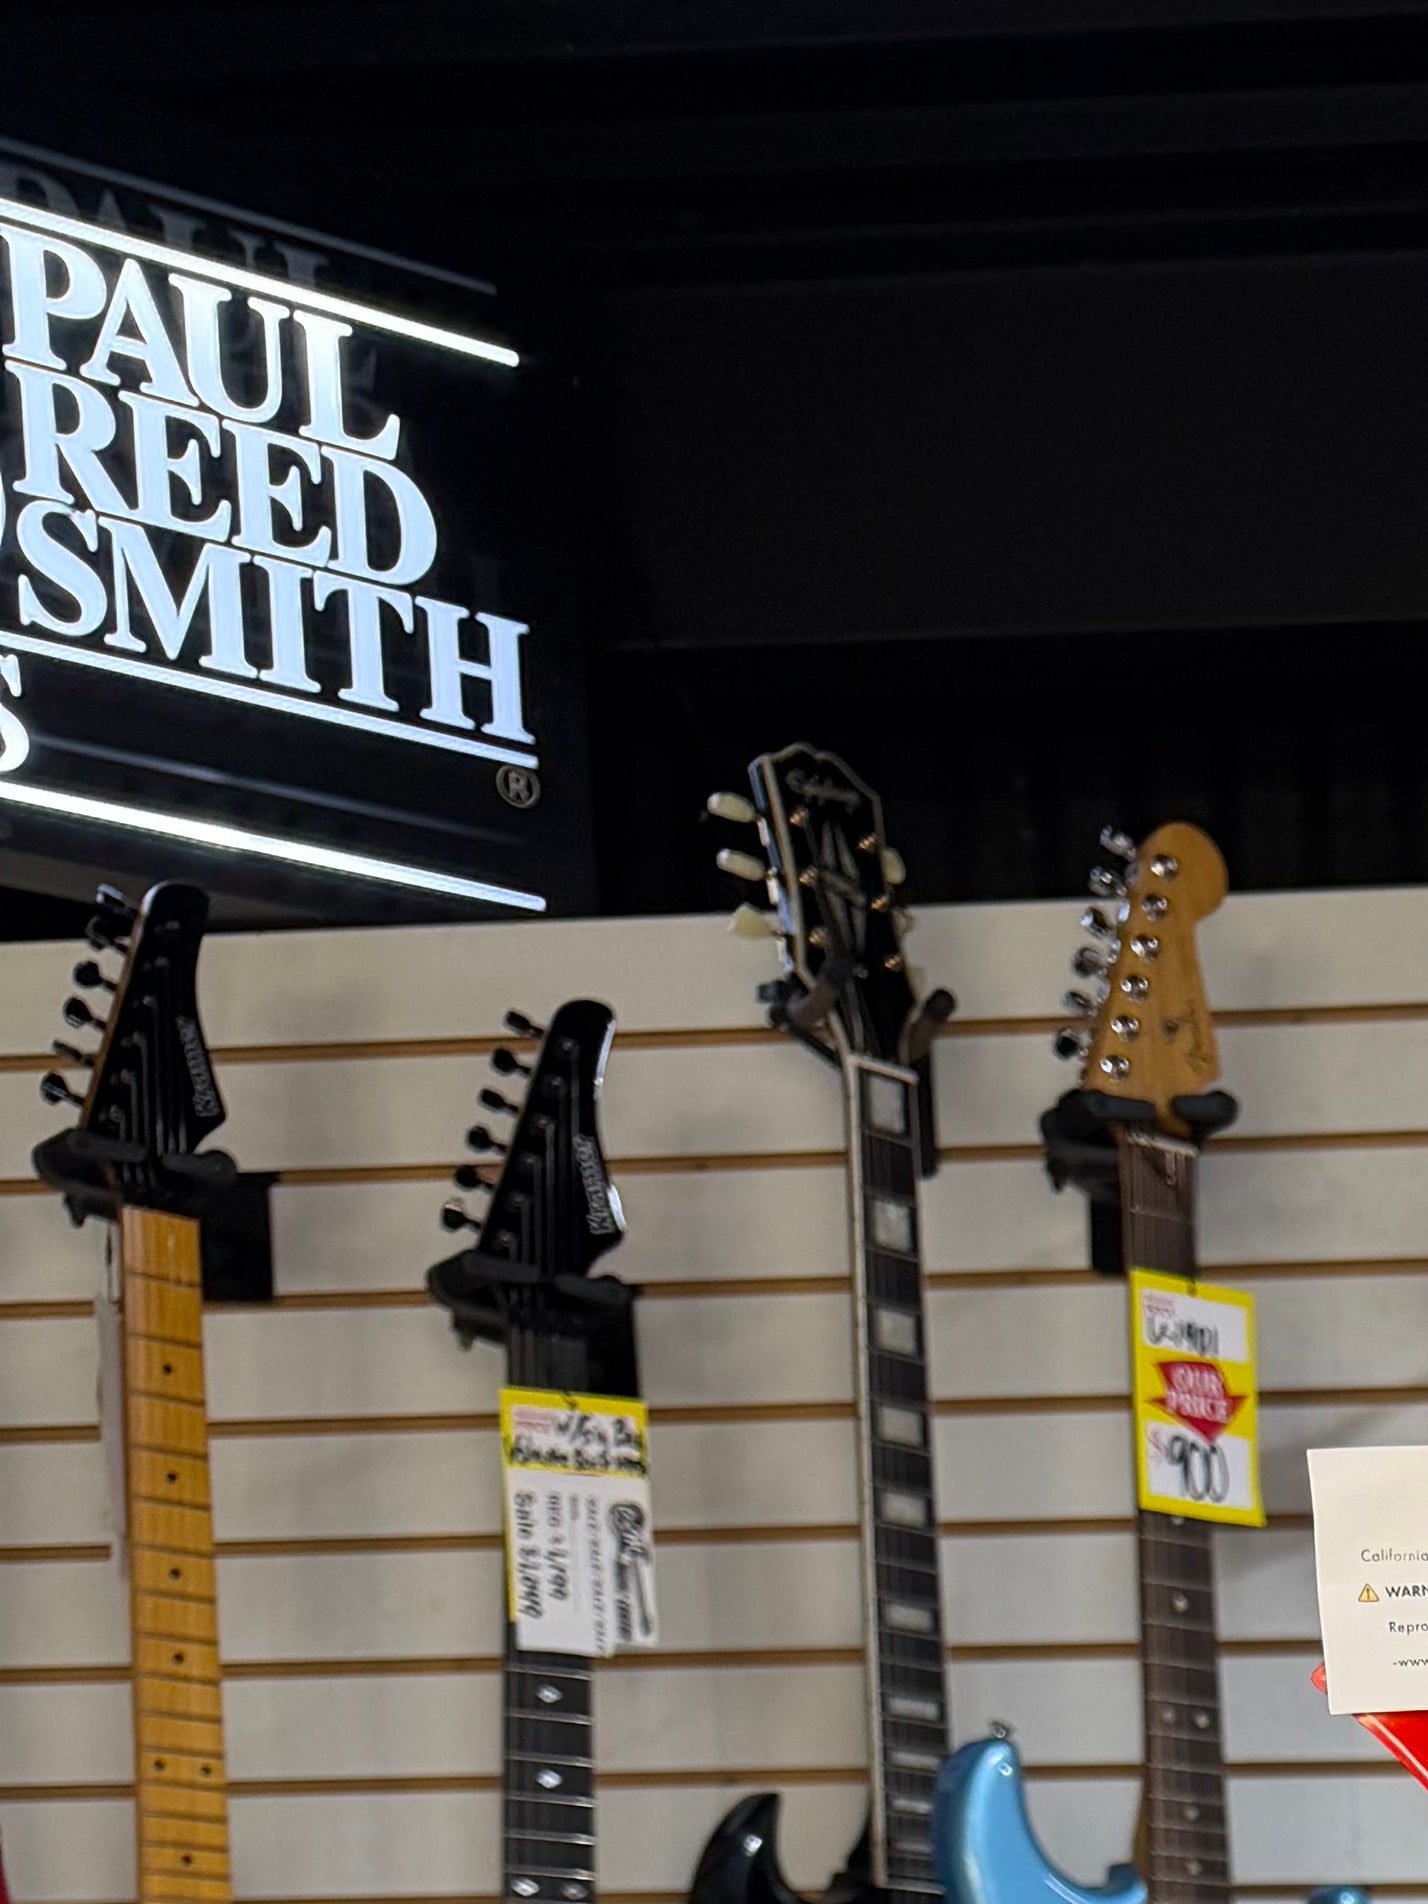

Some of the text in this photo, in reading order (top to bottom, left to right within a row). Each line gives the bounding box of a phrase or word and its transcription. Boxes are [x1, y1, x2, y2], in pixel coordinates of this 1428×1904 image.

[2, 226, 401, 461] PAUL
[5, 358, 439, 587] REED
[16, 499, 537, 746] SMITH
[1361, 1548, 1428, 1563] California
